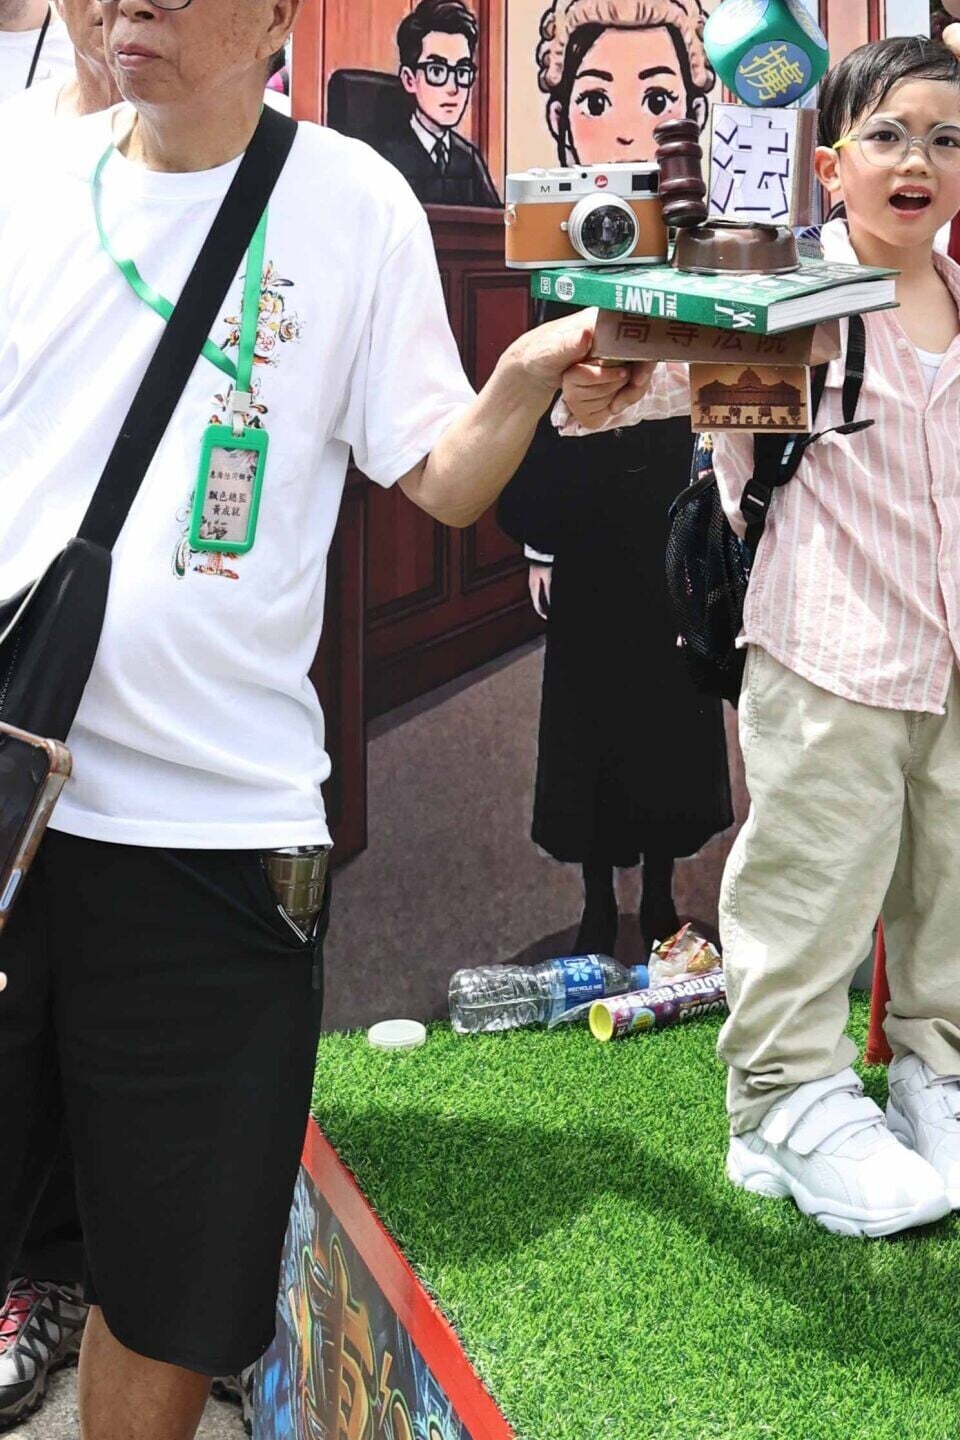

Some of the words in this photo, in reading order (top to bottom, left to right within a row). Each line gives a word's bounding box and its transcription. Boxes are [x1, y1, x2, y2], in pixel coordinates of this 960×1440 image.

[711, 115, 788, 218] 法
[540, 185, 551, 193] M
[615, 285, 623, 309] BOOK
[624, 286, 665, 317] LAW
[666, 293, 678, 318] THE
